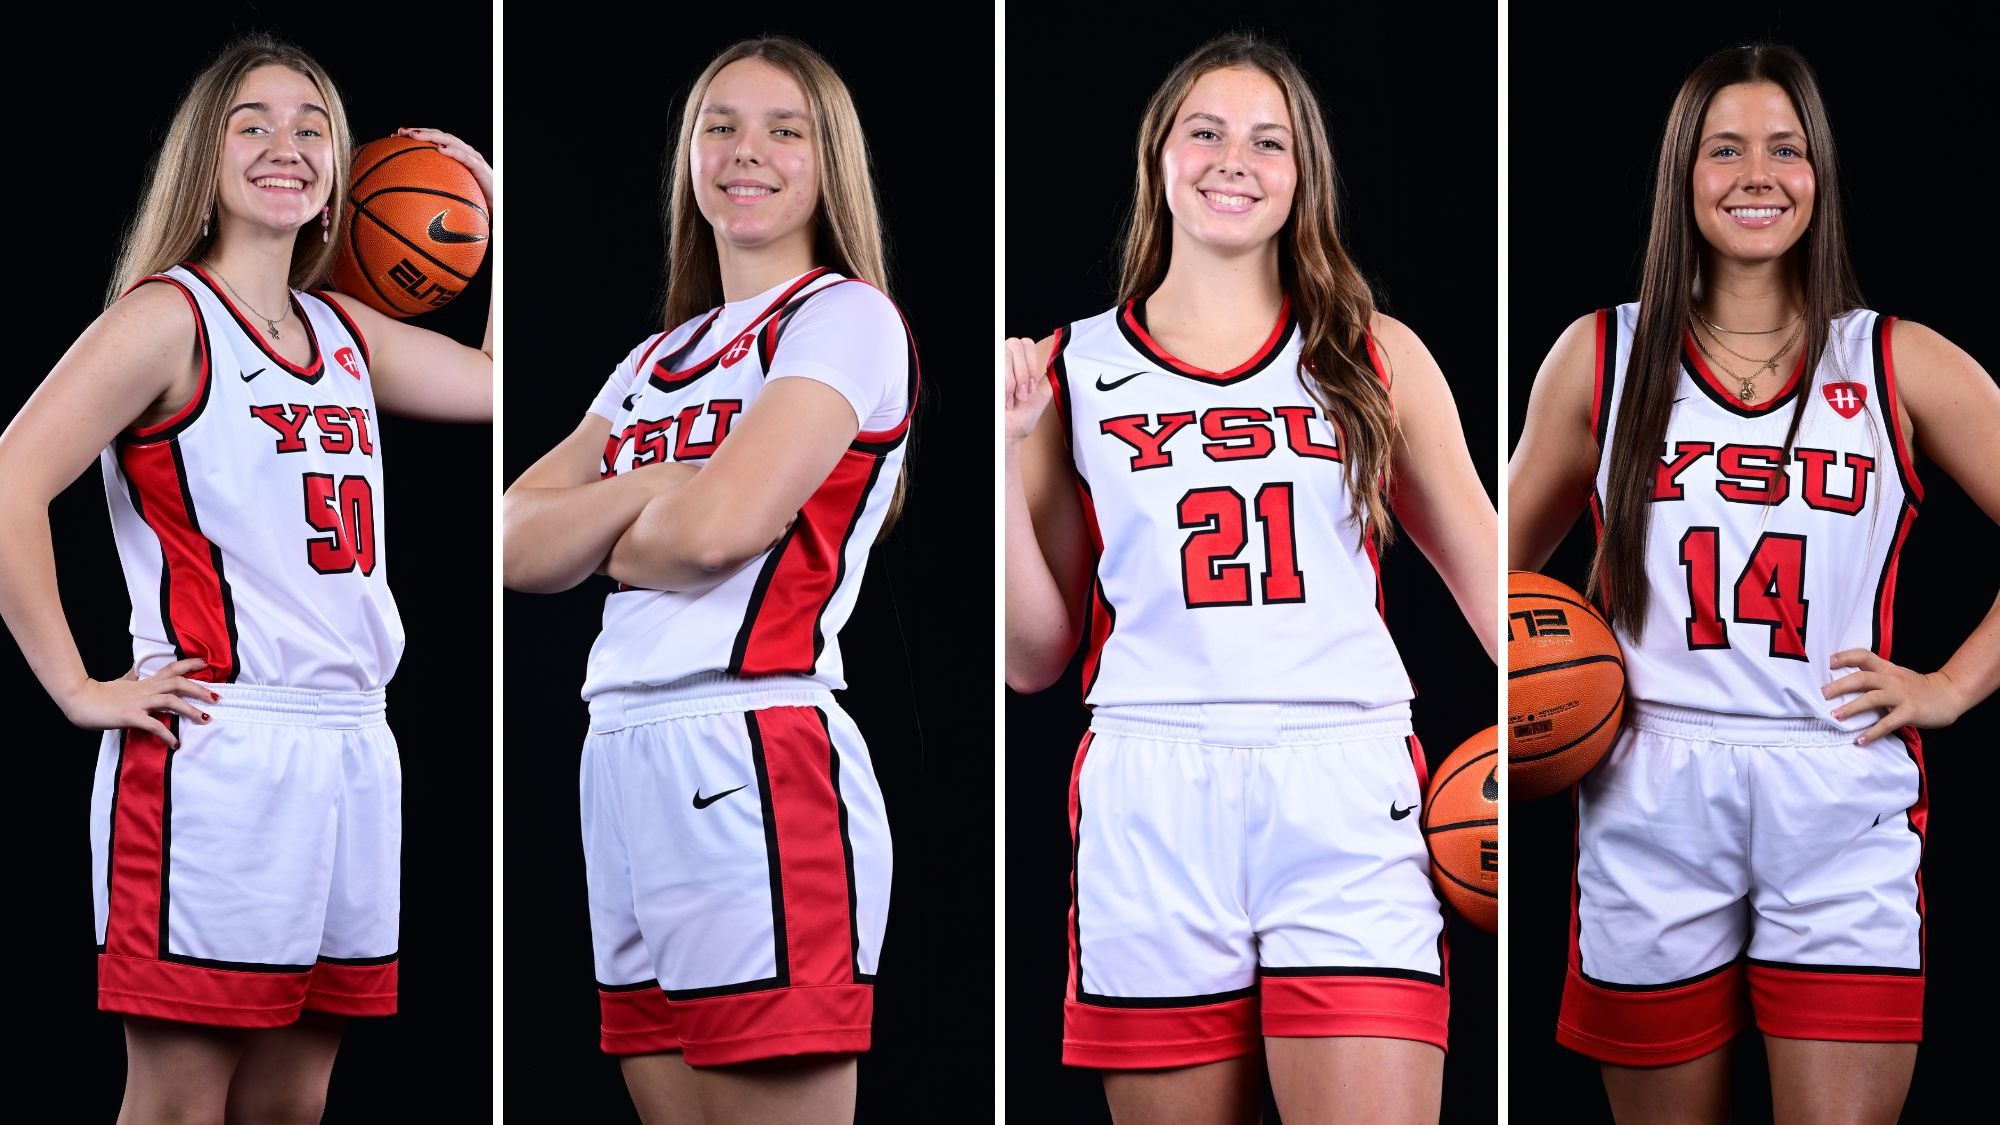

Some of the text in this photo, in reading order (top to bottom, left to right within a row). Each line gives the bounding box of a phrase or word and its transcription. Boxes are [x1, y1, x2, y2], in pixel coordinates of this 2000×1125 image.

[388, 258, 461, 307] ELITE
[302, 472, 376, 577] 50
[1176, 481, 1306, 610] 21
[1679, 526, 1810, 663] 14
